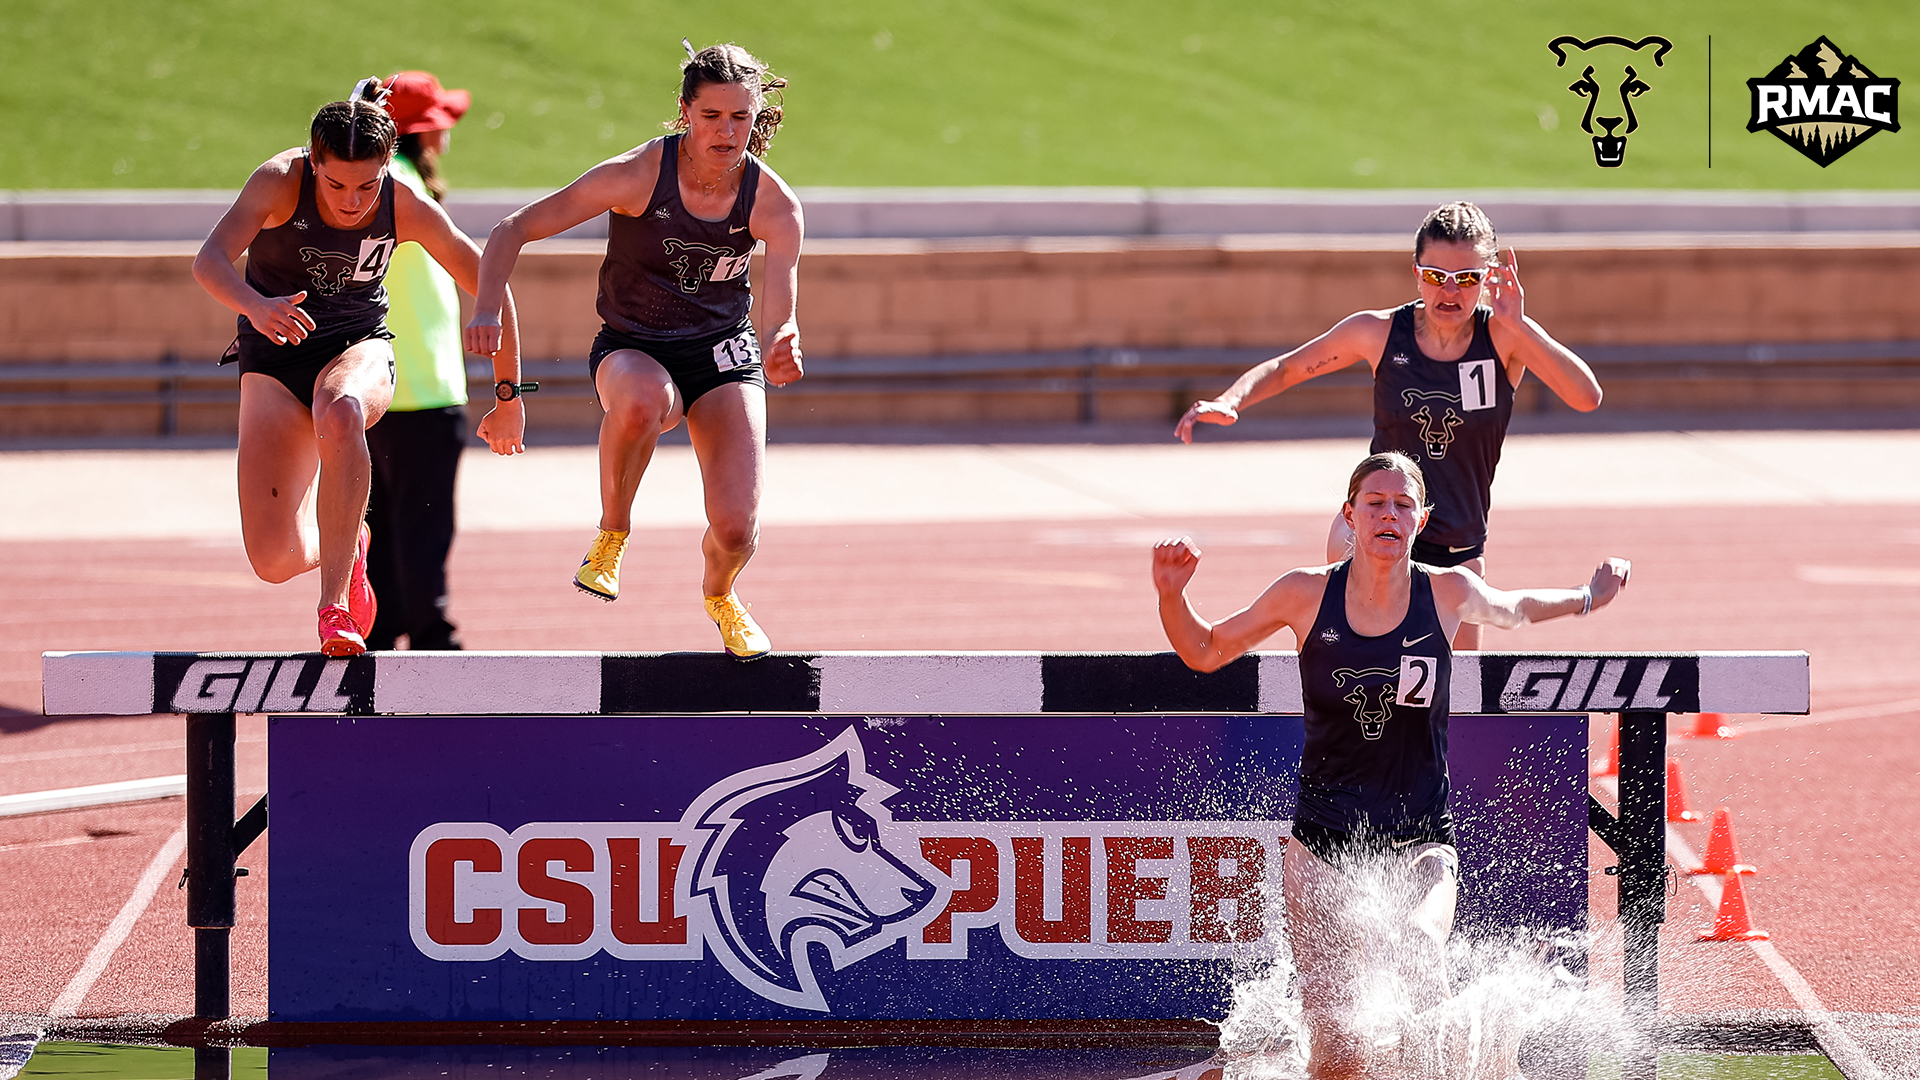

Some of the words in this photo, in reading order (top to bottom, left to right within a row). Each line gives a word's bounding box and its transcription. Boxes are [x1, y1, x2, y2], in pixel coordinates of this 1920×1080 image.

[359, 243, 384, 277] 4
[724, 253, 749, 280] 13
[721, 337, 752, 367] 13
[1469, 364, 1486, 406] 1
[170, 659, 351, 713] GILL
[1404, 660, 1429, 705] 2
[1499, 659, 1673, 711] GILL
[425, 838, 688, 945] CSU
[918, 836, 1290, 944] PUEB
